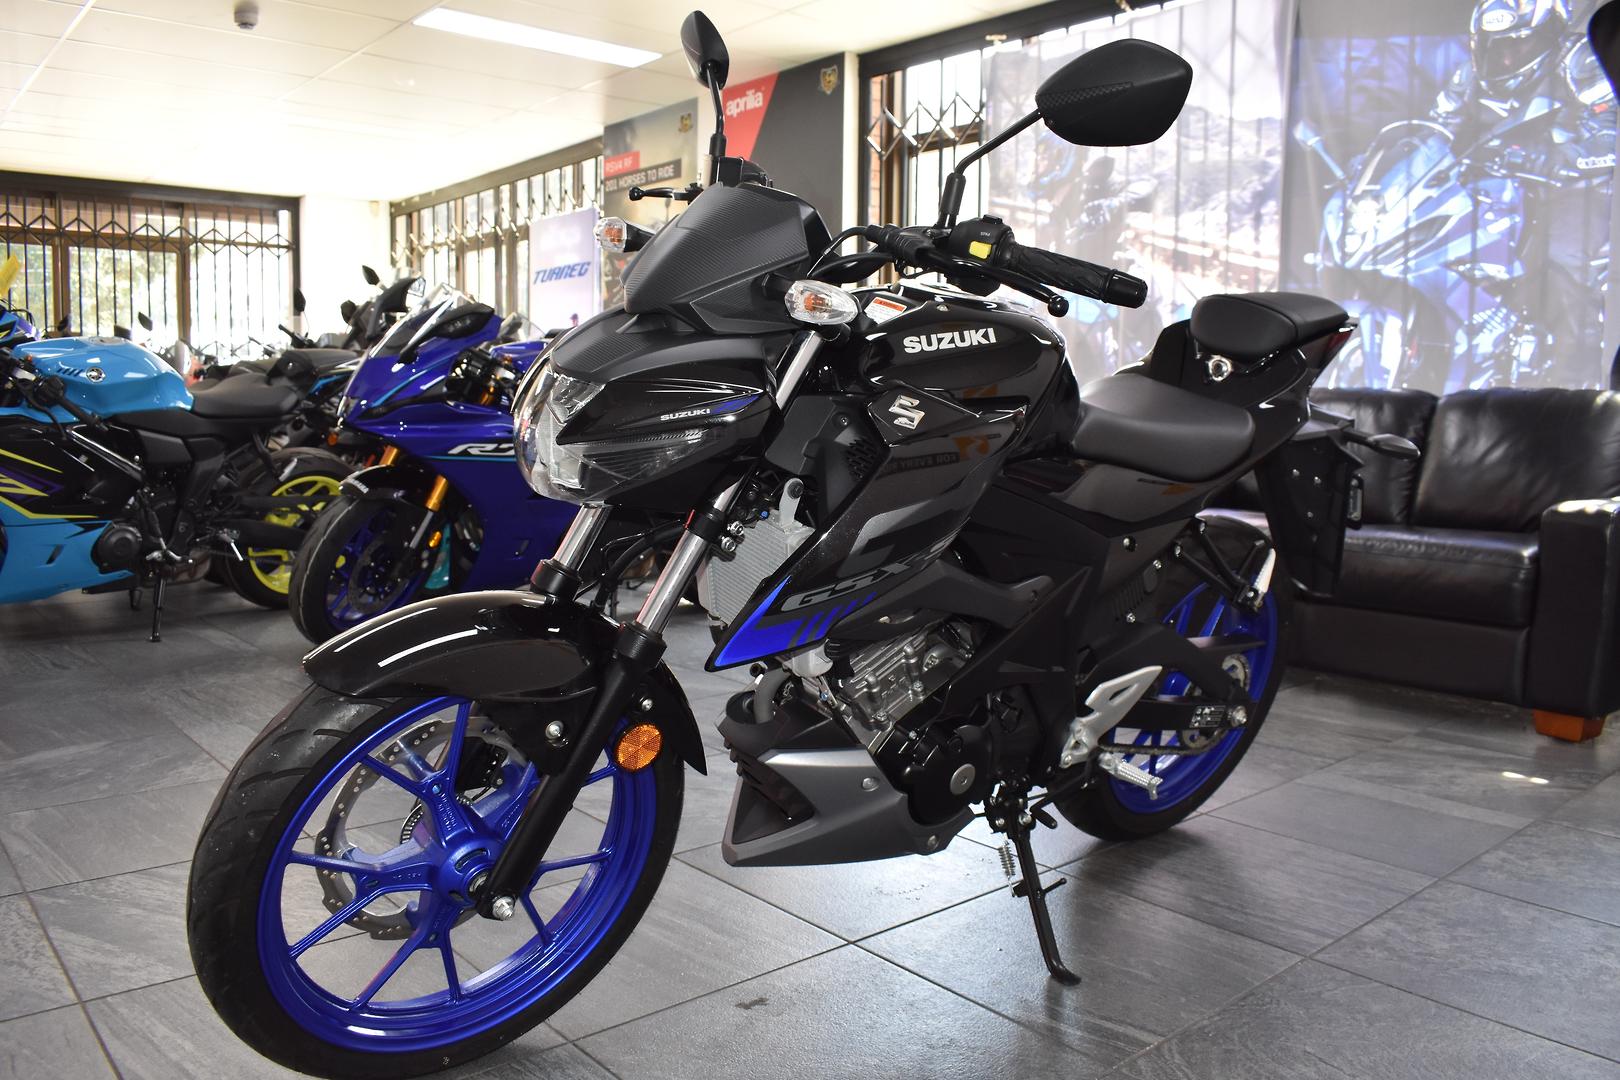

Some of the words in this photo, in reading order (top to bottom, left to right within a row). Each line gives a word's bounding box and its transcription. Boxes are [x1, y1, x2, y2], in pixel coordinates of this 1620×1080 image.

[726, 89, 763, 118] aprilia
[647, 168, 657, 182] TO
[658, 164, 675, 178] RIDE
[903, 327, 997, 353] SUZUKI
[660, 408, 711, 421] SUZUKI
